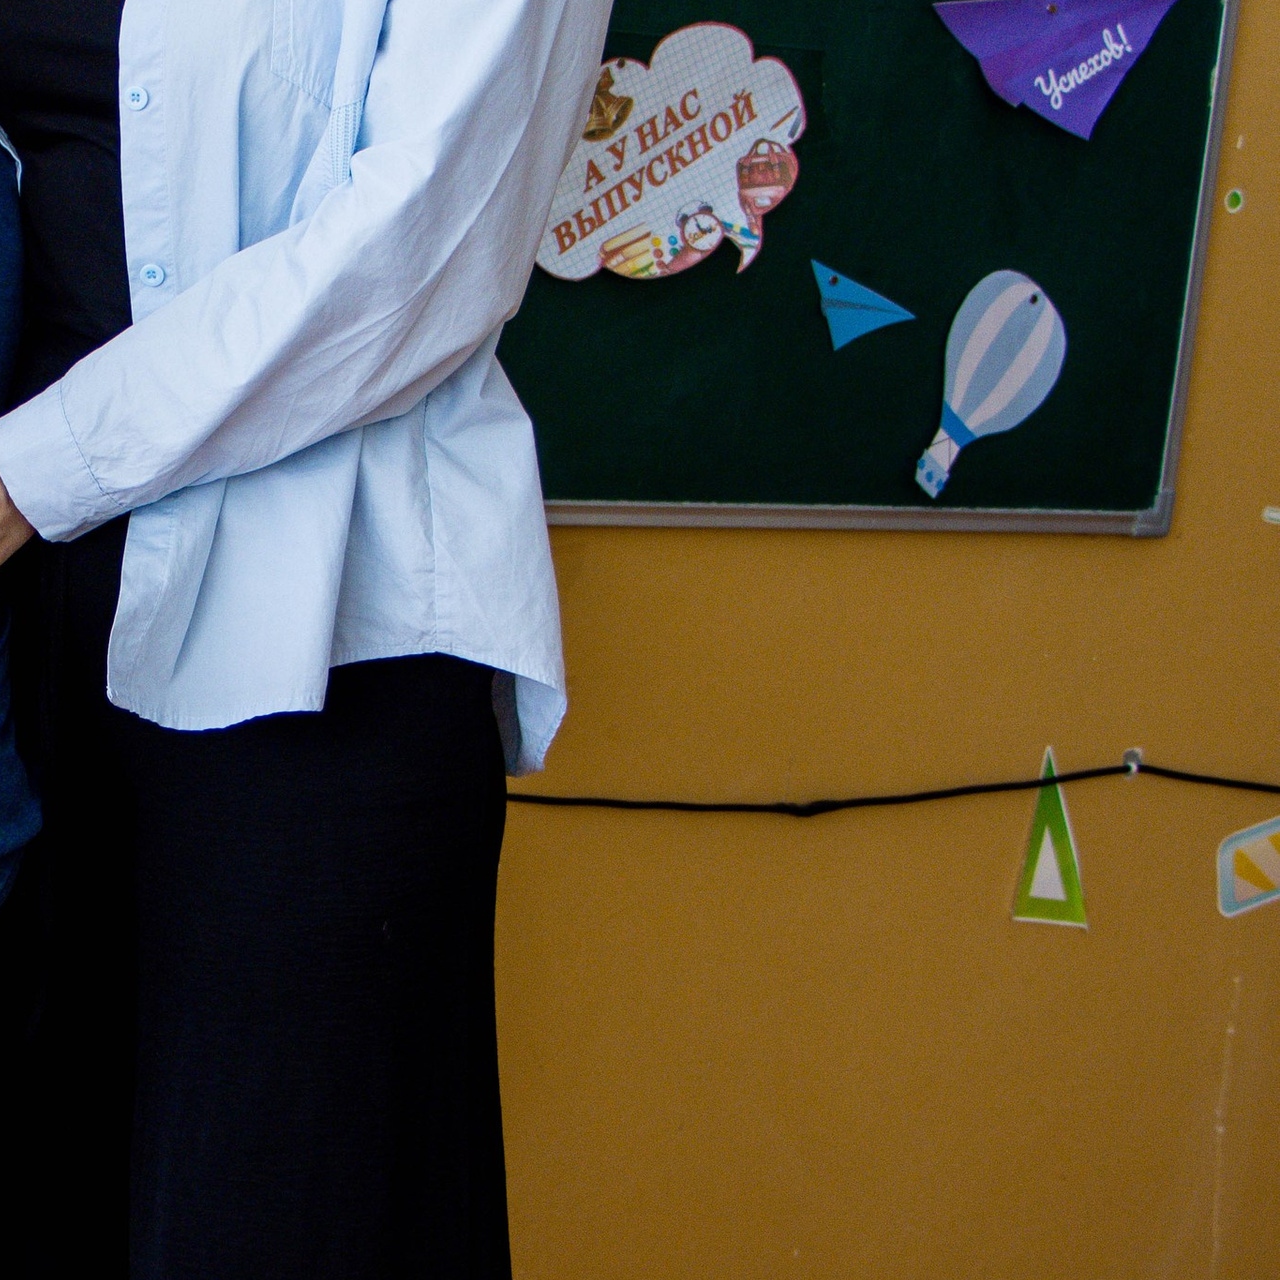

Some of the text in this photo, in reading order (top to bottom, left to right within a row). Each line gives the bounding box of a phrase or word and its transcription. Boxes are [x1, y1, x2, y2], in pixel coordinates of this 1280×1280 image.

[1034, 23, 1133, 110] Успехов!
[551, 89, 757, 256] ВЫПУСКНОЙ
[583, 88, 702, 193] А У НАС
